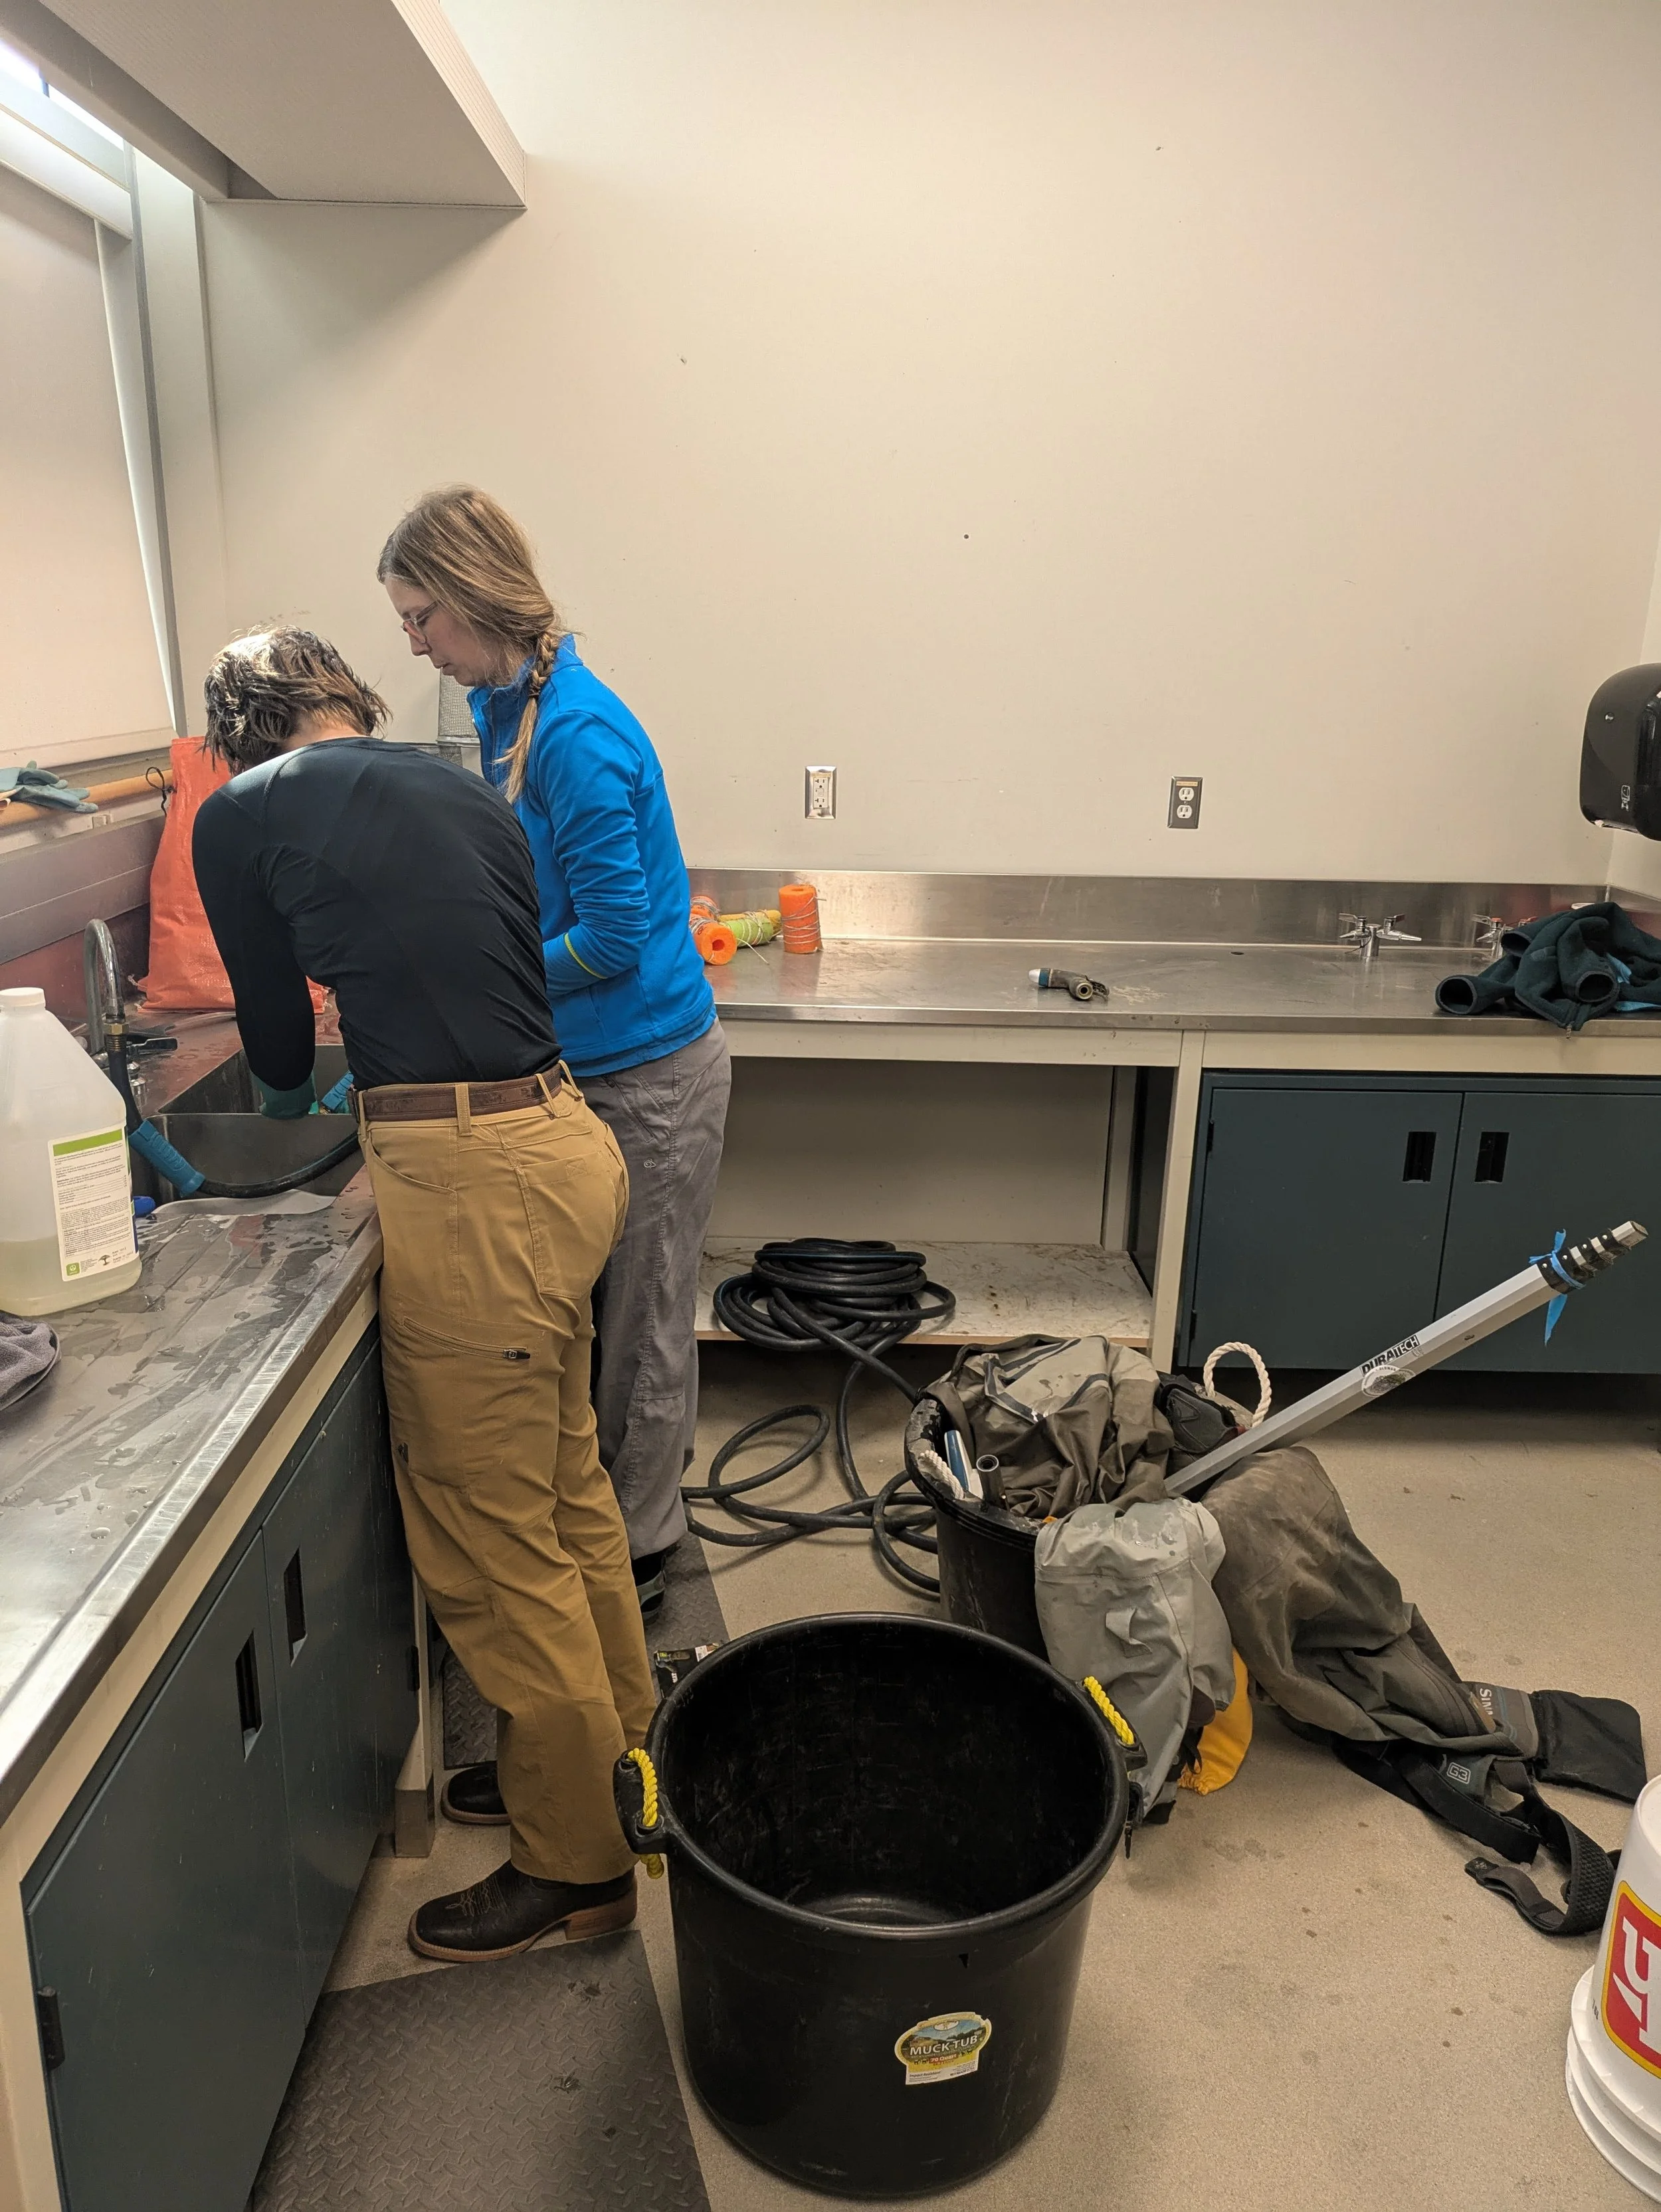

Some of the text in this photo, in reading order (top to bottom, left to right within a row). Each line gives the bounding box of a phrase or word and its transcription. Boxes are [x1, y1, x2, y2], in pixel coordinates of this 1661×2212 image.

[1361, 1336, 1419, 1375] DURATECH
[1449, 1765, 1468, 1781] G3
[910, 2035, 978, 2055] MUCK TUB
